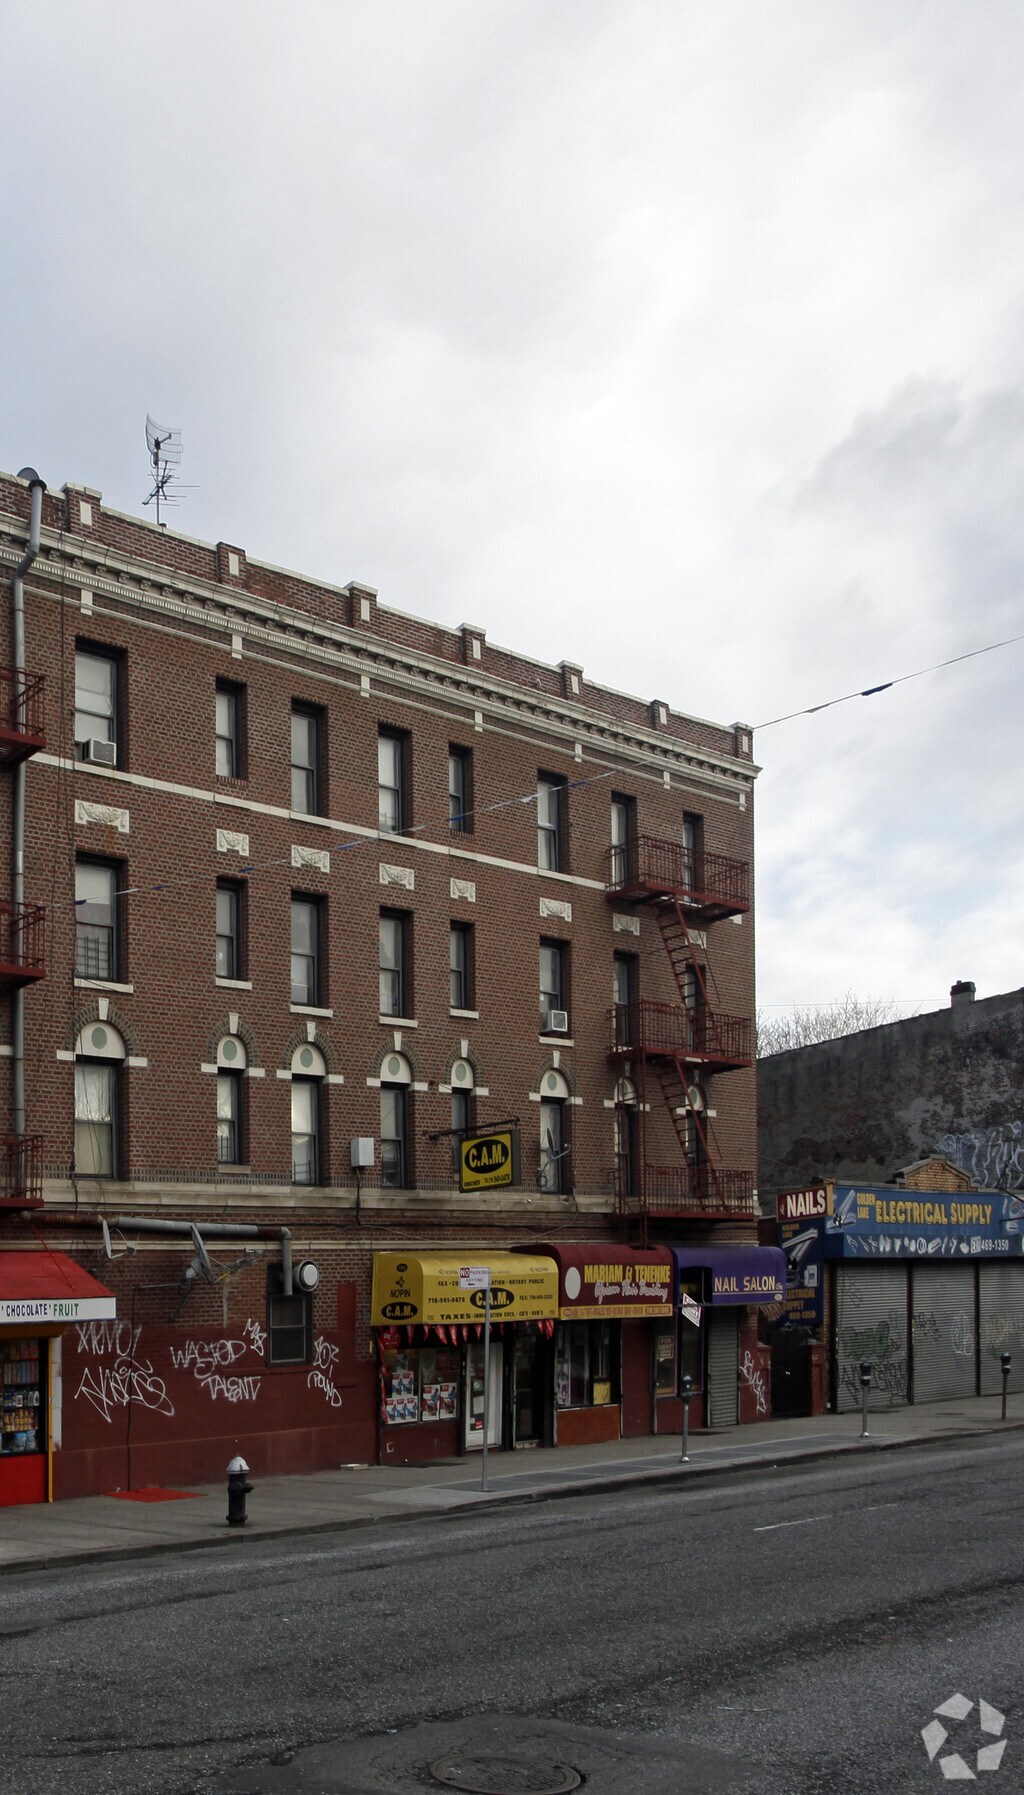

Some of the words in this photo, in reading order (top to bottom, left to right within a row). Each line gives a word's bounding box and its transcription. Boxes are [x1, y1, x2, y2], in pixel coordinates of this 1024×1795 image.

[469, 1143, 505, 1168] C.A.M.
[786, 1189, 826, 1218] NAILS
[856, 1192, 876, 1205] GOLDEN
[875, 1199, 948, 1225] ELECTRICAL
[950, 1202, 992, 1225] SUPPLY
[460, 1267, 470, 1278] NO
[584, 1264, 623, 1283] MARIAM
[714, 1276, 739, 1292] NAIL
[743, 1275, 775, 1291] SALON
[389, 1288, 411, 1298] NOPIN
[786, 1287, 816, 1299] LECTRICAL
[6, 1303, 48, 1317] CHOCOLATE
[53, 1303, 80, 1317] FRUIT
[386, 1305, 414, 1317] C.A.M.
[169, 1339, 247, 1379] WASTED
[200, 1374, 262, 1403] TALENT
[306, 1370, 342, 1407] POUND
